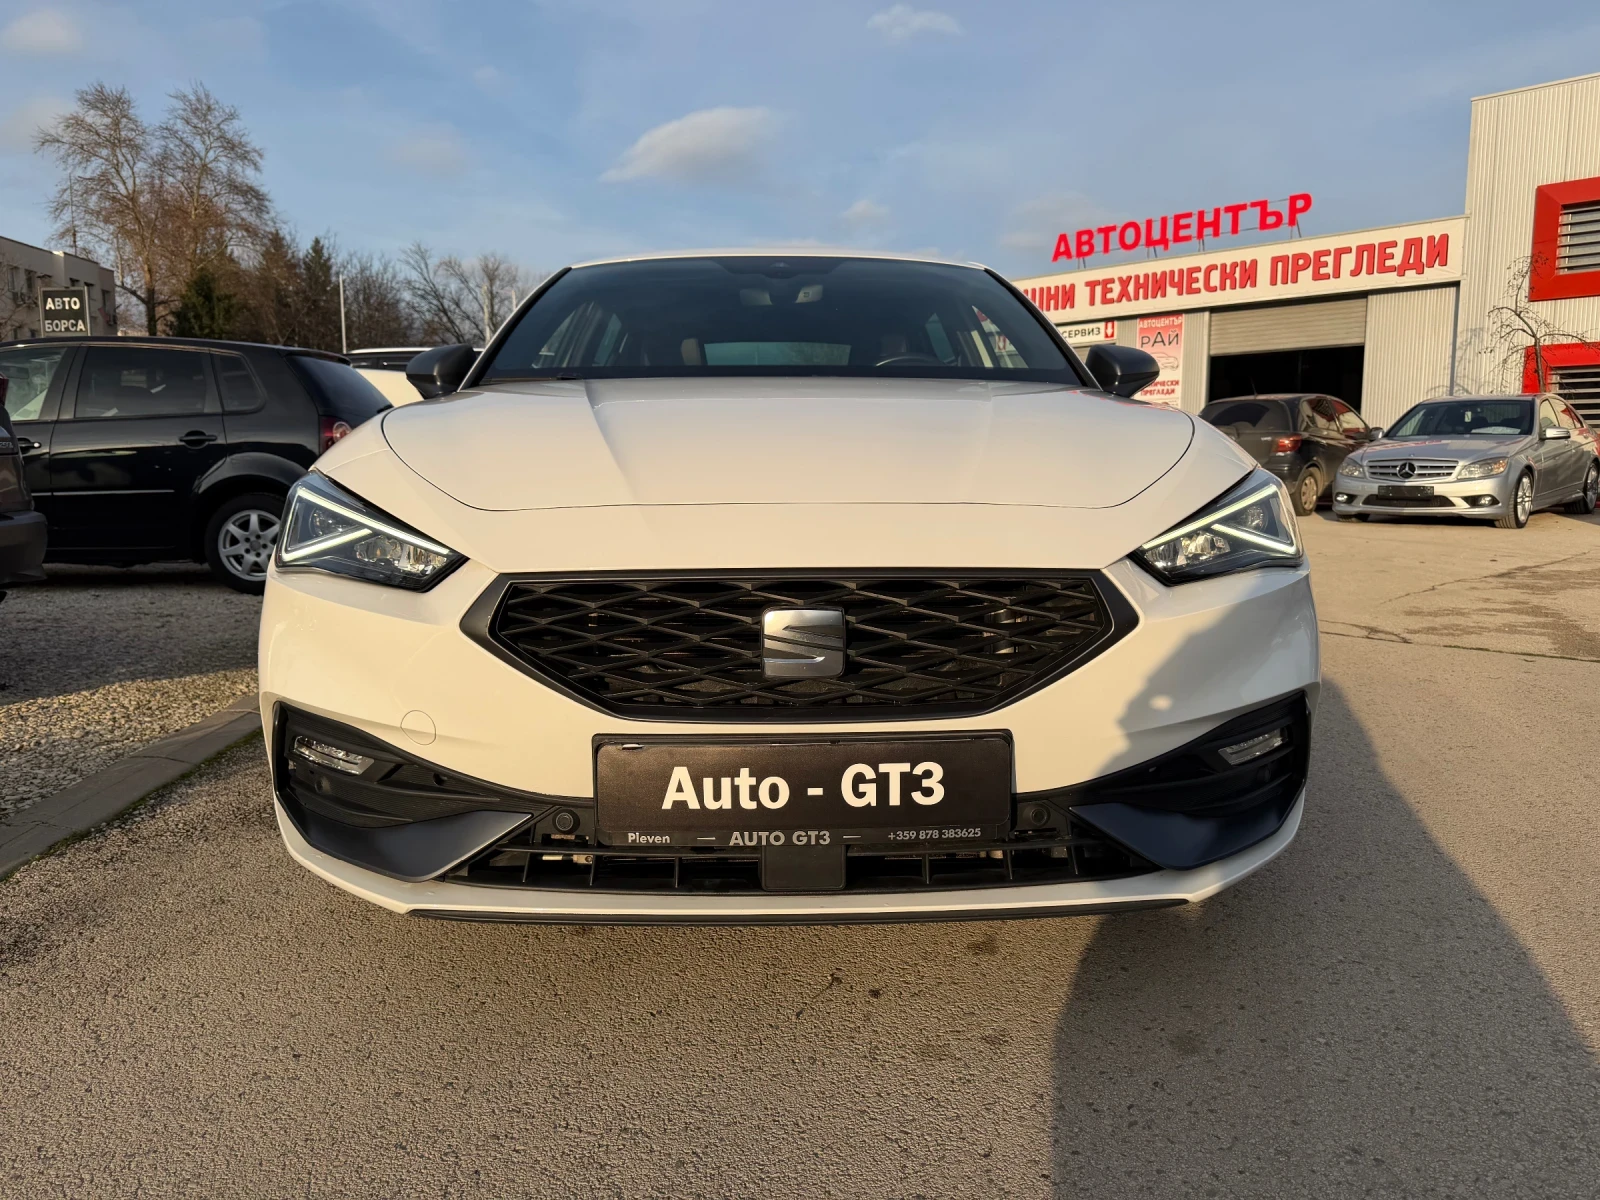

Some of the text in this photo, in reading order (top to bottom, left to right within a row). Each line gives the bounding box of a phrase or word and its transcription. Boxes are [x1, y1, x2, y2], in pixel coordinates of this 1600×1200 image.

[1052, 193, 1313, 263] АВТОЦЕНТЪР
[1023, 233, 1449, 312] ШНИ ТЕХНИЧЕСКИ ПРЕГЛЕДИ
[45, 297, 81, 311] АВТО
[44, 319, 86, 332] БОРСА
[1139, 316, 1183, 328] АВТОЦЕНТЪР
[1062, 327, 1101, 340] СЕРВИЗ
[661, 761, 945, 810] Auto - GT3
[627, 832, 671, 844] Pleven
[729, 830, 831, 846] AUTO GT3
[888, 827, 981, 840] +359 878 383625
